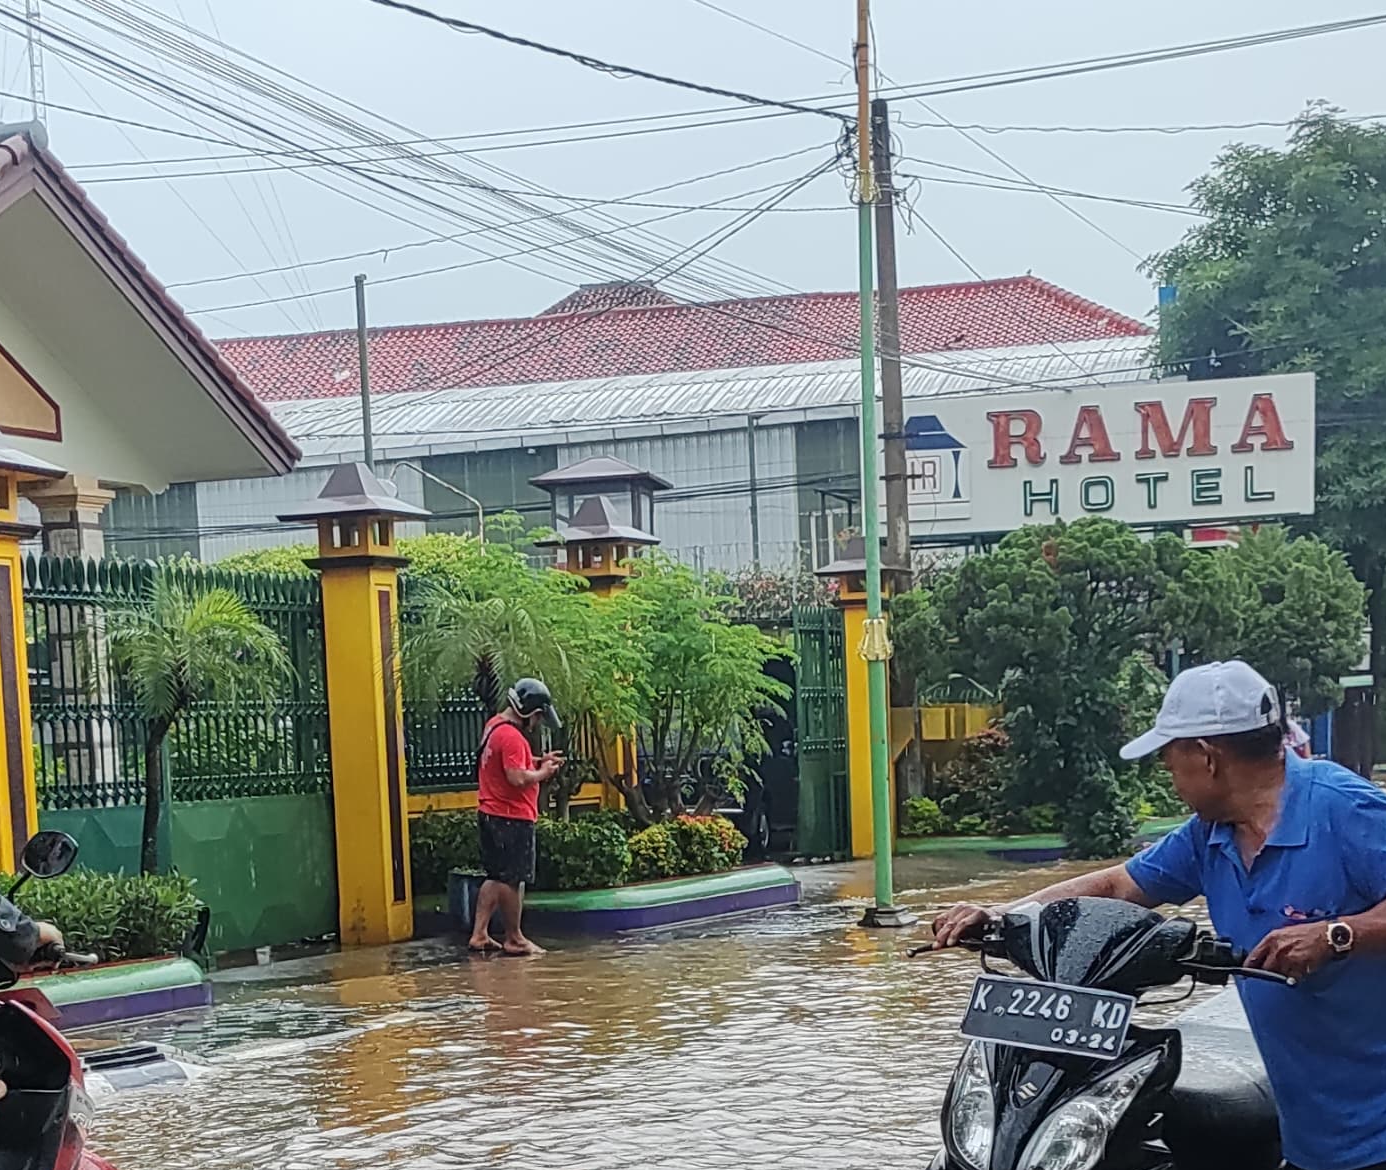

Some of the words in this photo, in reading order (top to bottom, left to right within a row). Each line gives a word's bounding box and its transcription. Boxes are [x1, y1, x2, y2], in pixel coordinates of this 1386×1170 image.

[987, 392, 1295, 469] RAMA
[1023, 465, 1276, 517] HOTEL
[973, 983, 993, 1011] K
[1007, 988, 1073, 1020] 2246
[1090, 1000, 1127, 1030] KD
